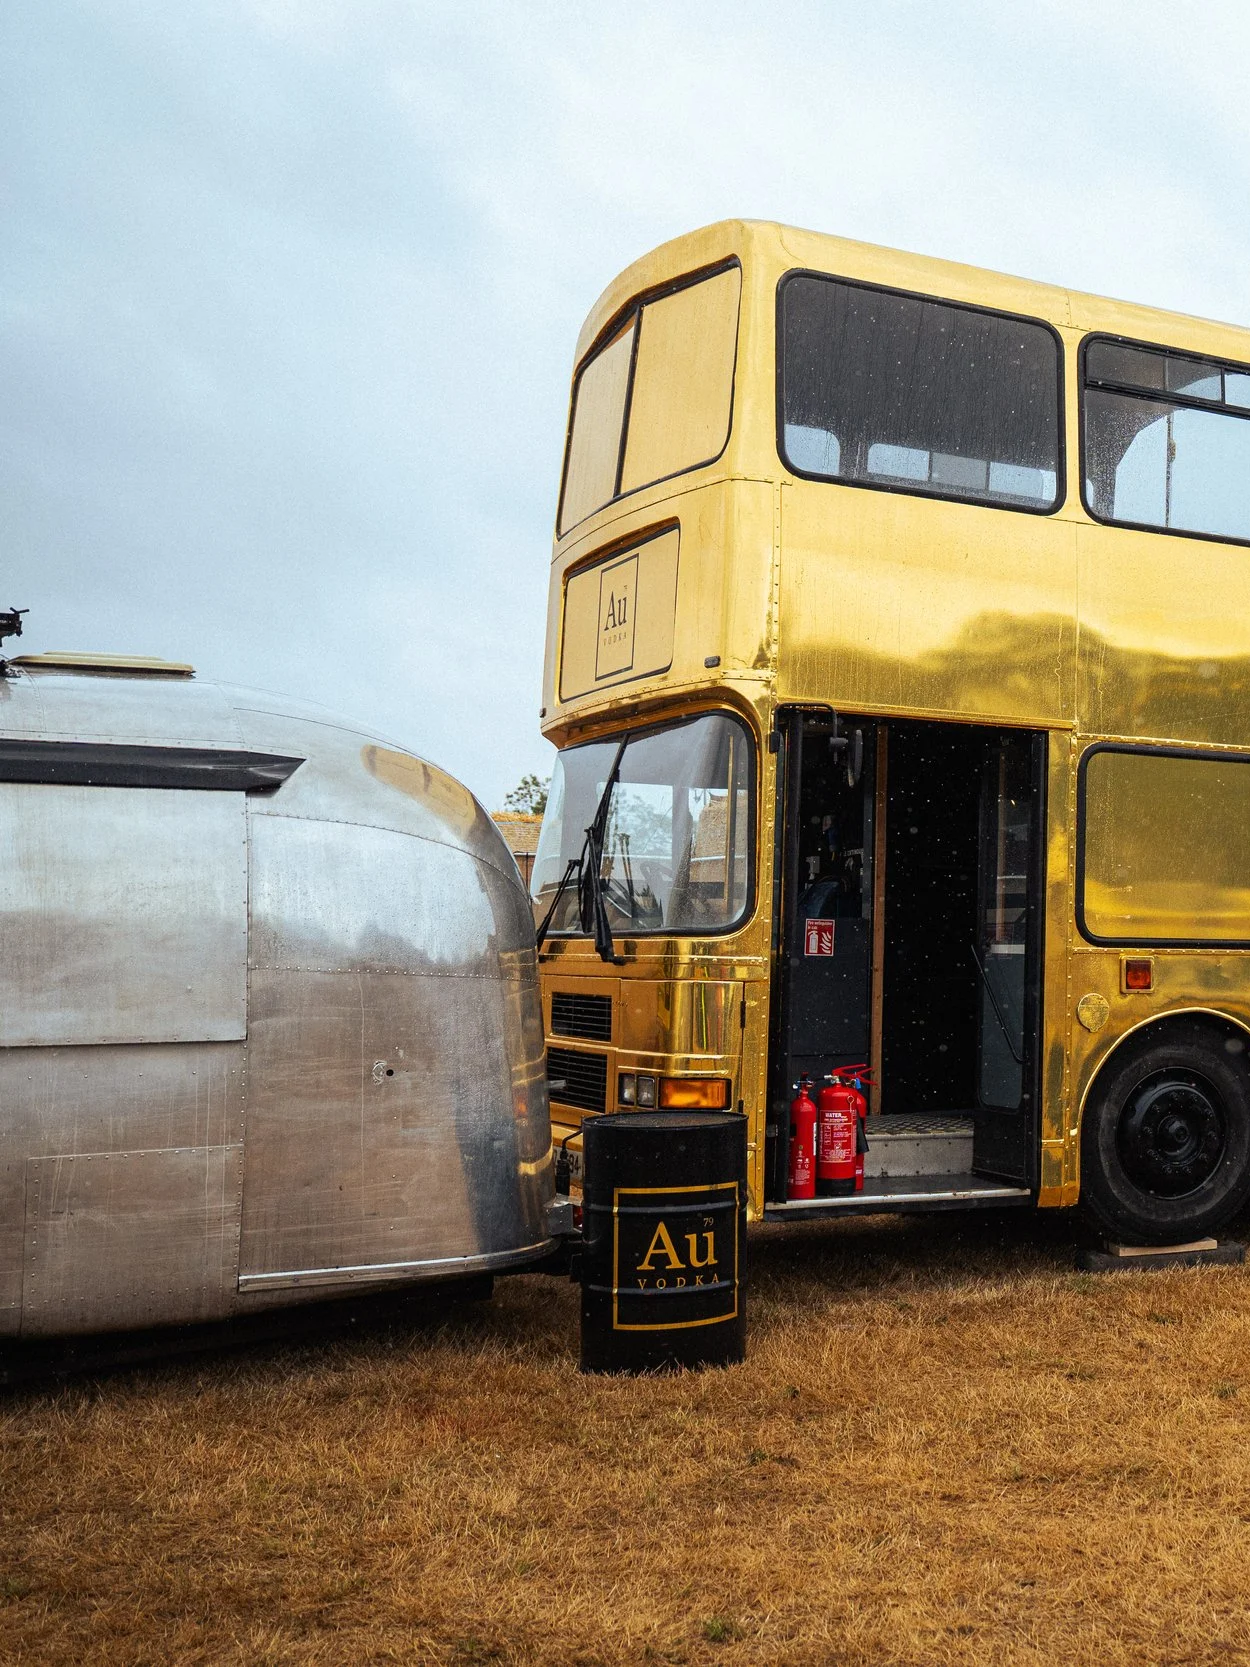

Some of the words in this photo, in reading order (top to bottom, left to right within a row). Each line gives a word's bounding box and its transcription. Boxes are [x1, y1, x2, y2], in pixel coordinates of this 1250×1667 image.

[604, 591, 627, 631] Au
[703, 1217, 714, 1227] 79
[636, 1221, 718, 1270] Au
[637, 1273, 719, 1290] VODKA
